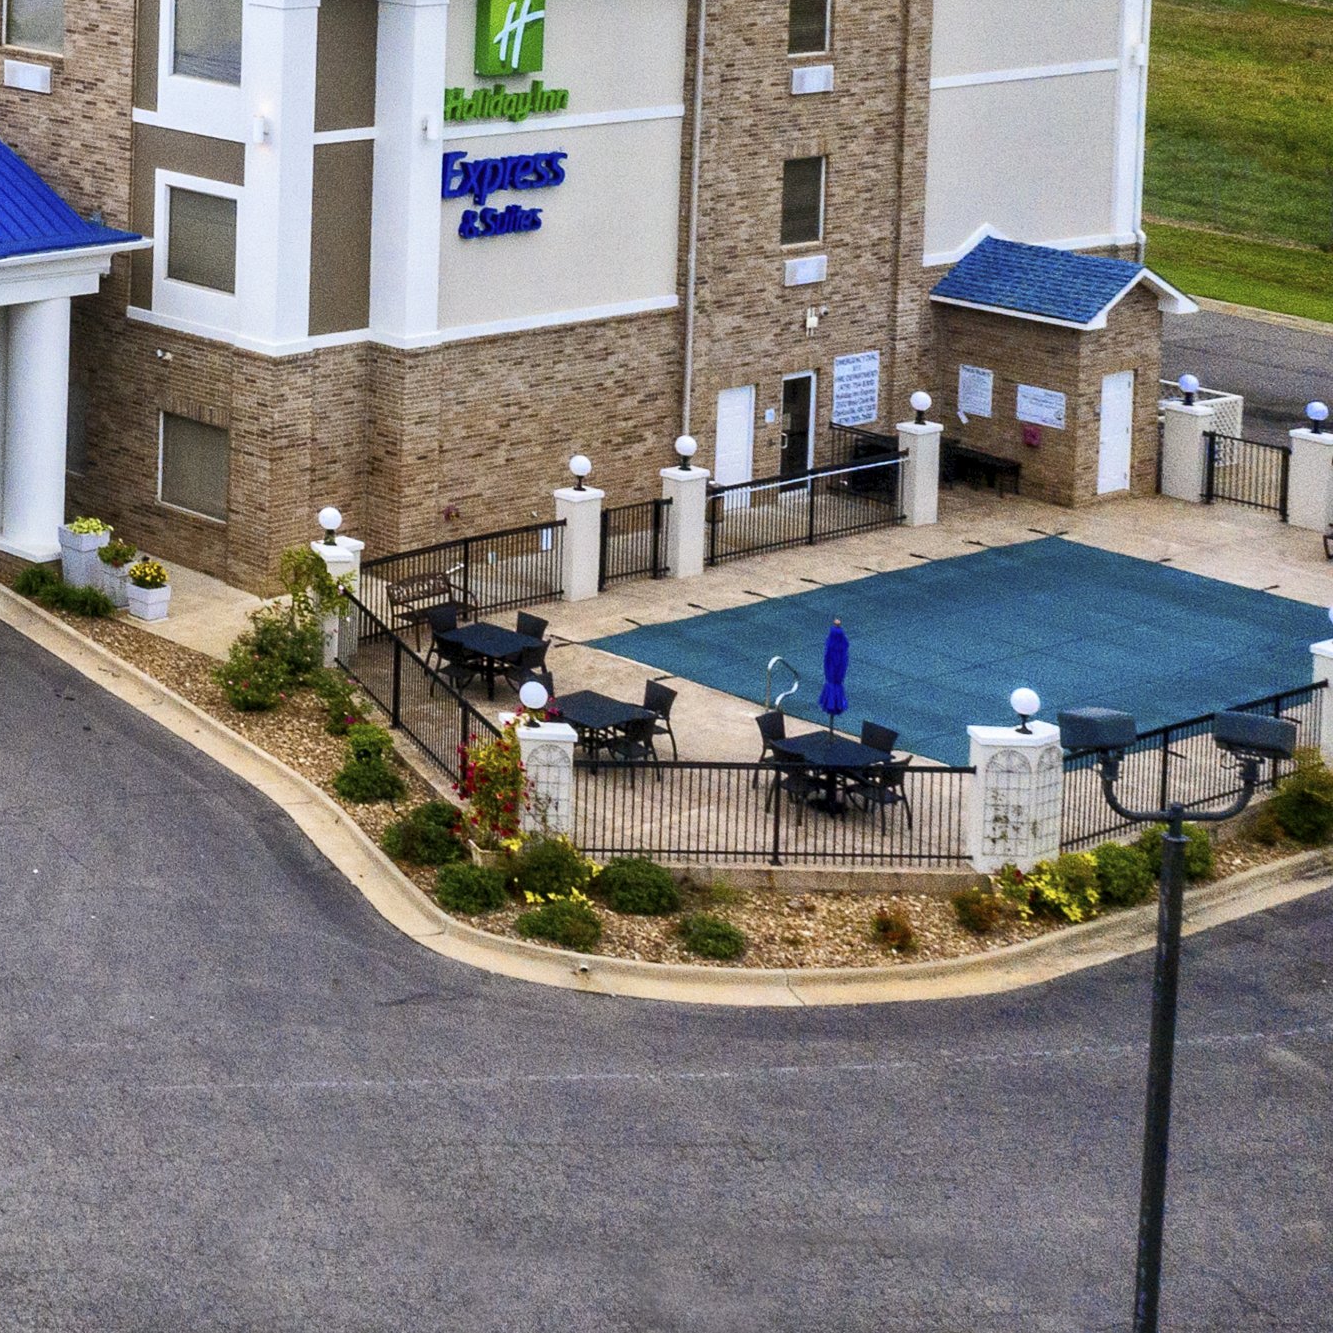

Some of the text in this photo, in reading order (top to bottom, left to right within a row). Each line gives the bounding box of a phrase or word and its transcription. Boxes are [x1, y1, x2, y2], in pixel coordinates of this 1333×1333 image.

[443, 80, 569, 123] Holiday Inn
[442, 150, 568, 206] Express
[459, 204, 543, 239] & Suites
